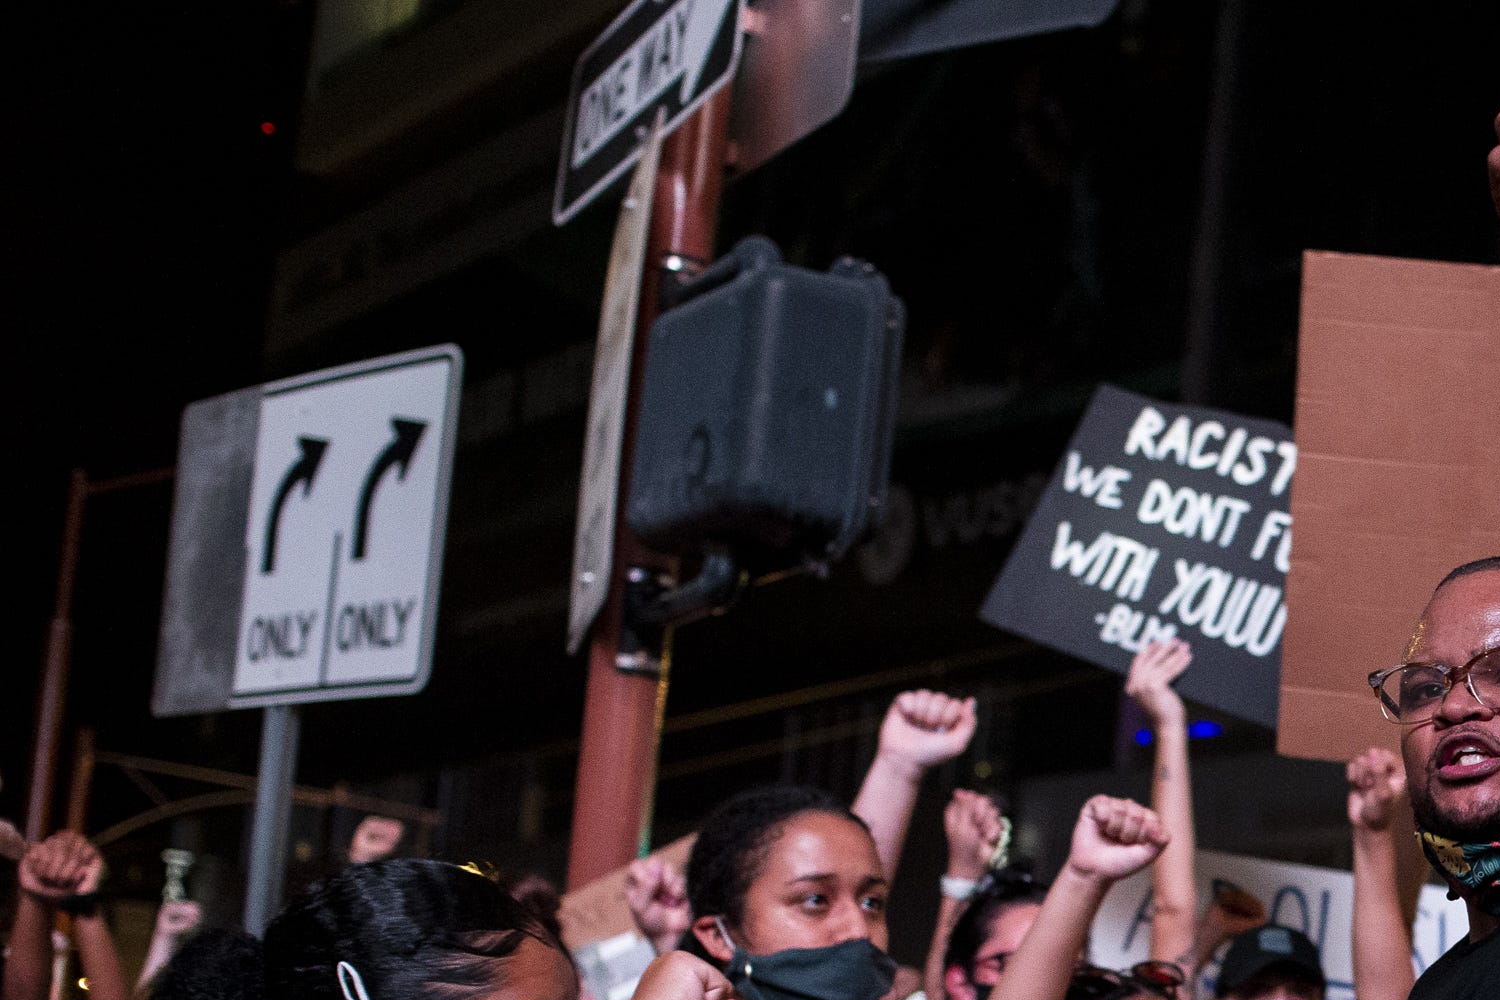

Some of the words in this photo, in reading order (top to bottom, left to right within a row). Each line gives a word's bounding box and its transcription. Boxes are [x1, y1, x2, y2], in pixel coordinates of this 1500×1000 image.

[580, 56, 632, 150] ONE
[638, 1, 696, 99] WAY
[1063, 450, 1132, 510] WE
[1138, 479, 1252, 549] DONT
[1051, 521, 1161, 602] WITH
[247, 608, 318, 661] ONLY
[336, 595, 417, 652] ONLY
